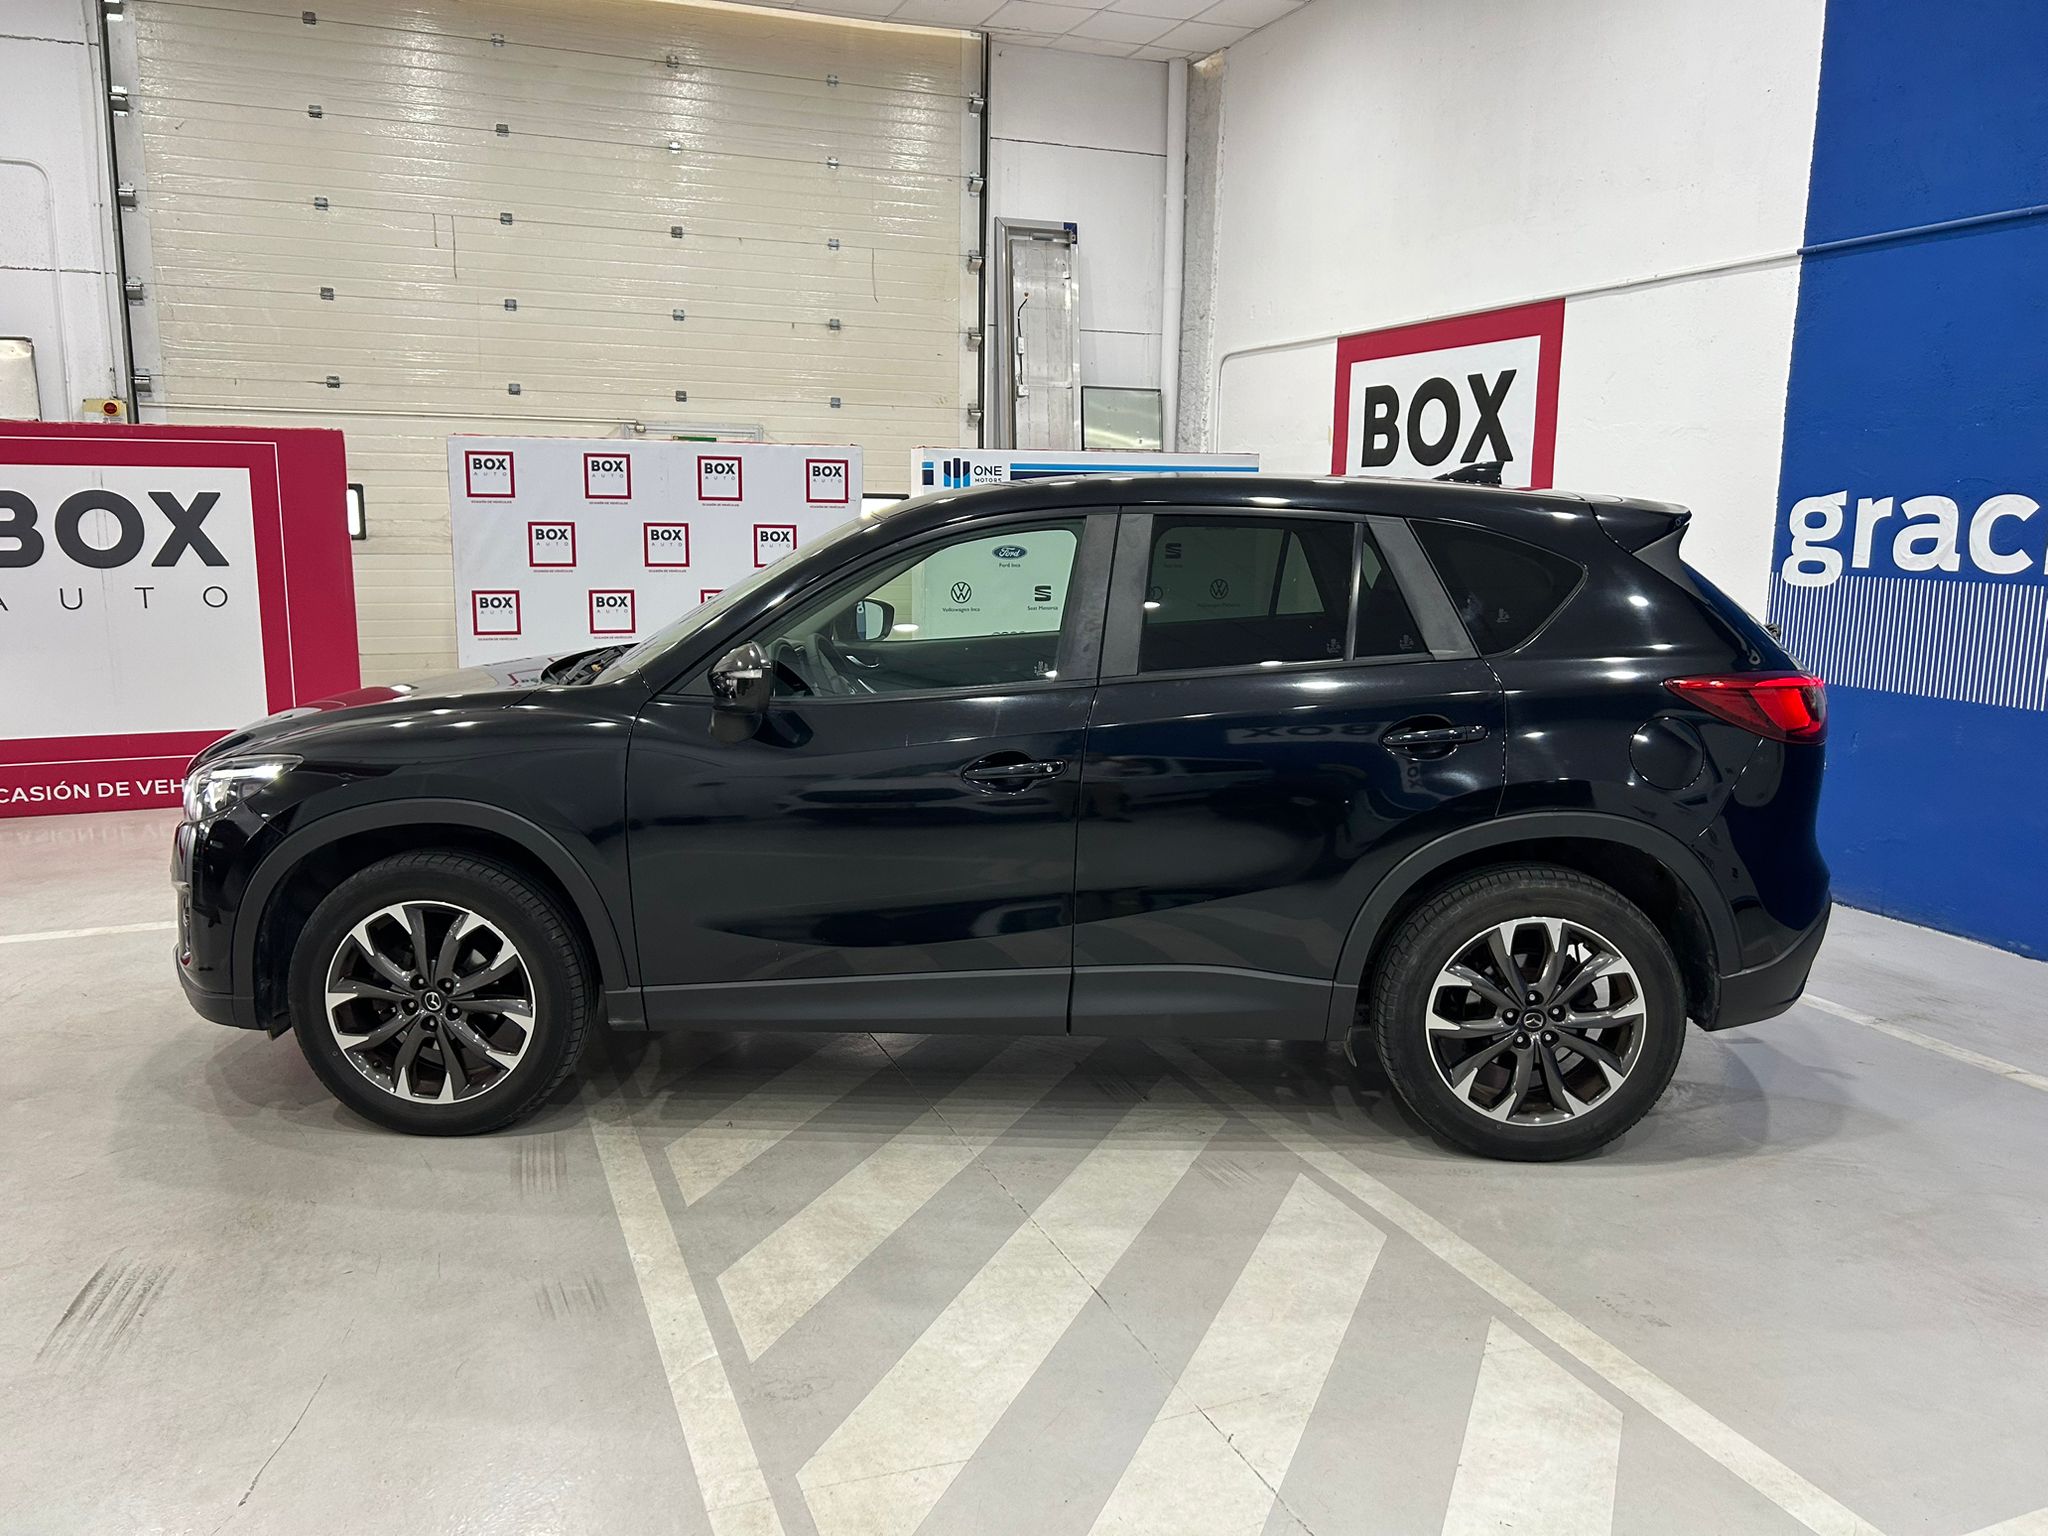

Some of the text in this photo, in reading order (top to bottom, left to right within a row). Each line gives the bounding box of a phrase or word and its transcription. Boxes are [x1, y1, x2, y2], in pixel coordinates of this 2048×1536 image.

[1361, 369, 1517, 467] BOX
[473, 458, 507, 470] BOX
[590, 460, 624, 472] BOX
[704, 463, 736, 474] BOX
[812, 466, 842, 478] BOX
[973, 465, 1002, 476] ONE
[535, 529, 569, 540] BOX
[650, 529, 682, 541] BOX
[760, 531, 791, 542] BOX
[1782, 490, 2048, 588] grac
[479, 597, 513, 608] BOX
[595, 596, 628, 607] BOX
[97, 781, 131, 798] DE
